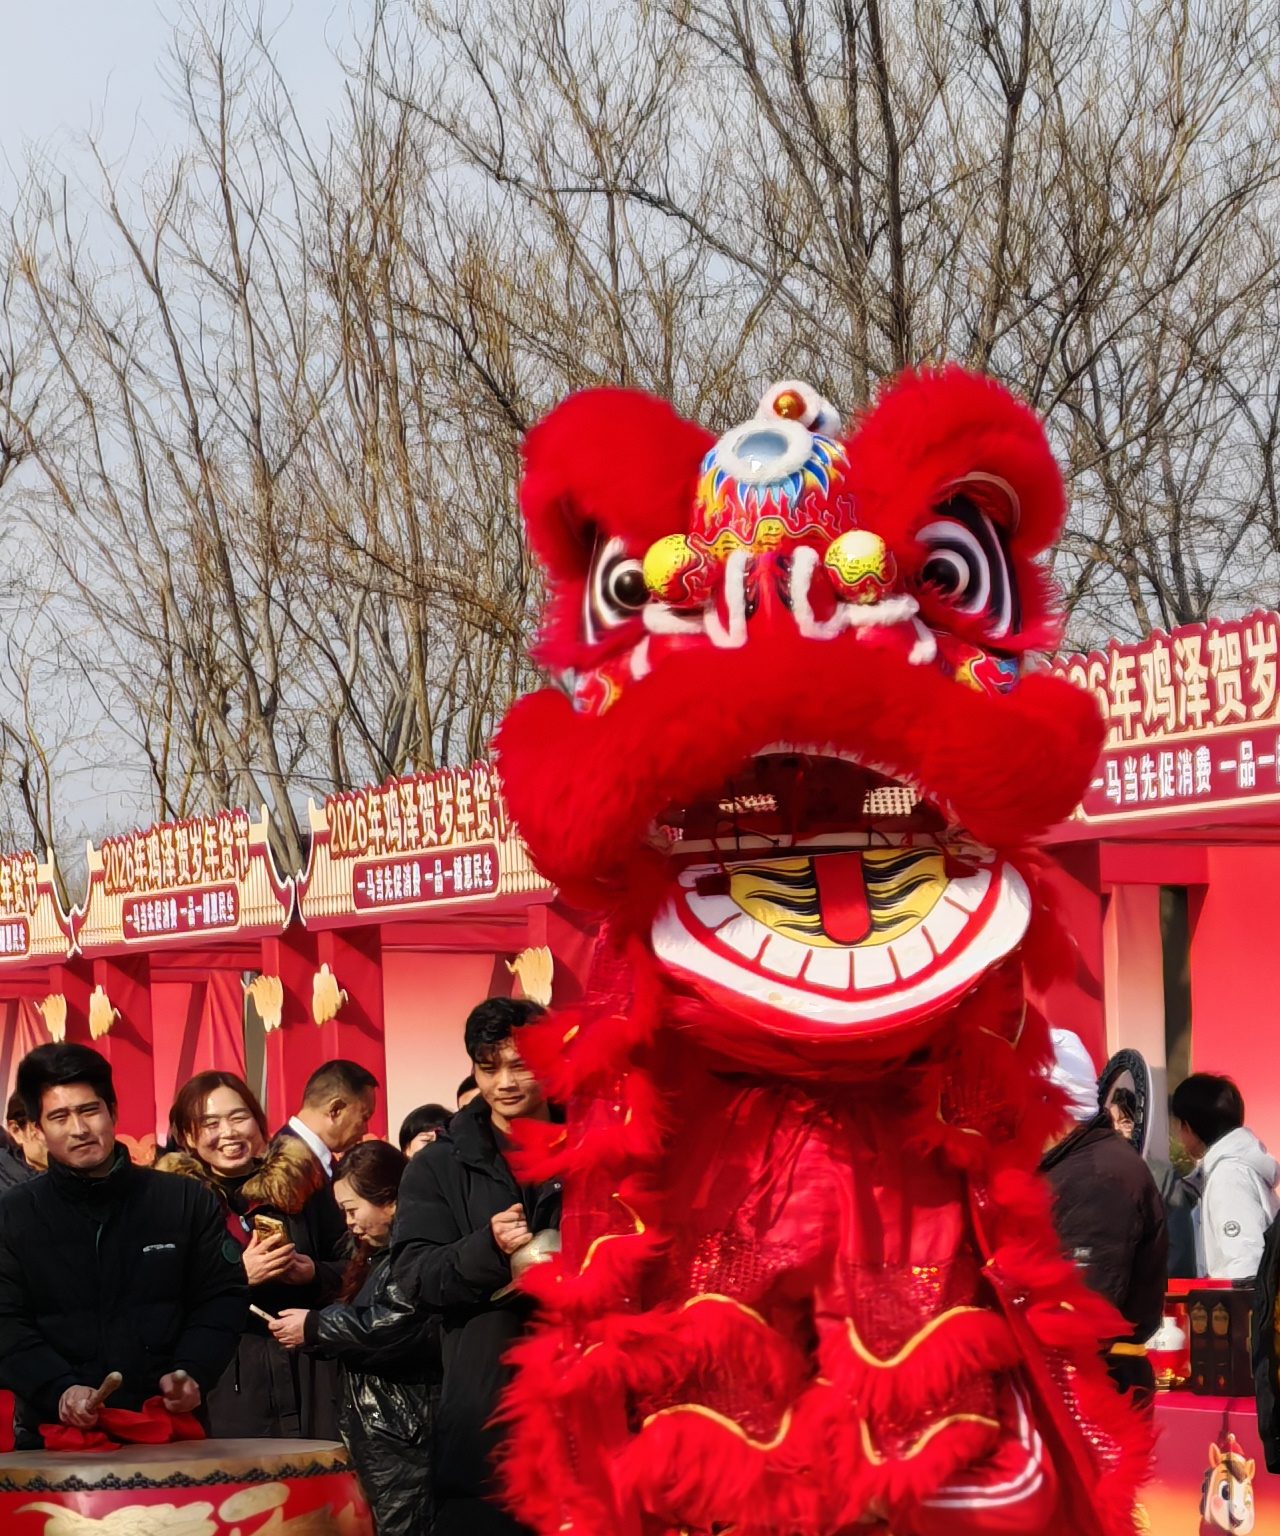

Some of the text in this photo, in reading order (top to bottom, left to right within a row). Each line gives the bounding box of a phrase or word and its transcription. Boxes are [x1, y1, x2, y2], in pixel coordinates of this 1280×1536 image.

[1091, 745, 1212, 804] 一马当先促消费
